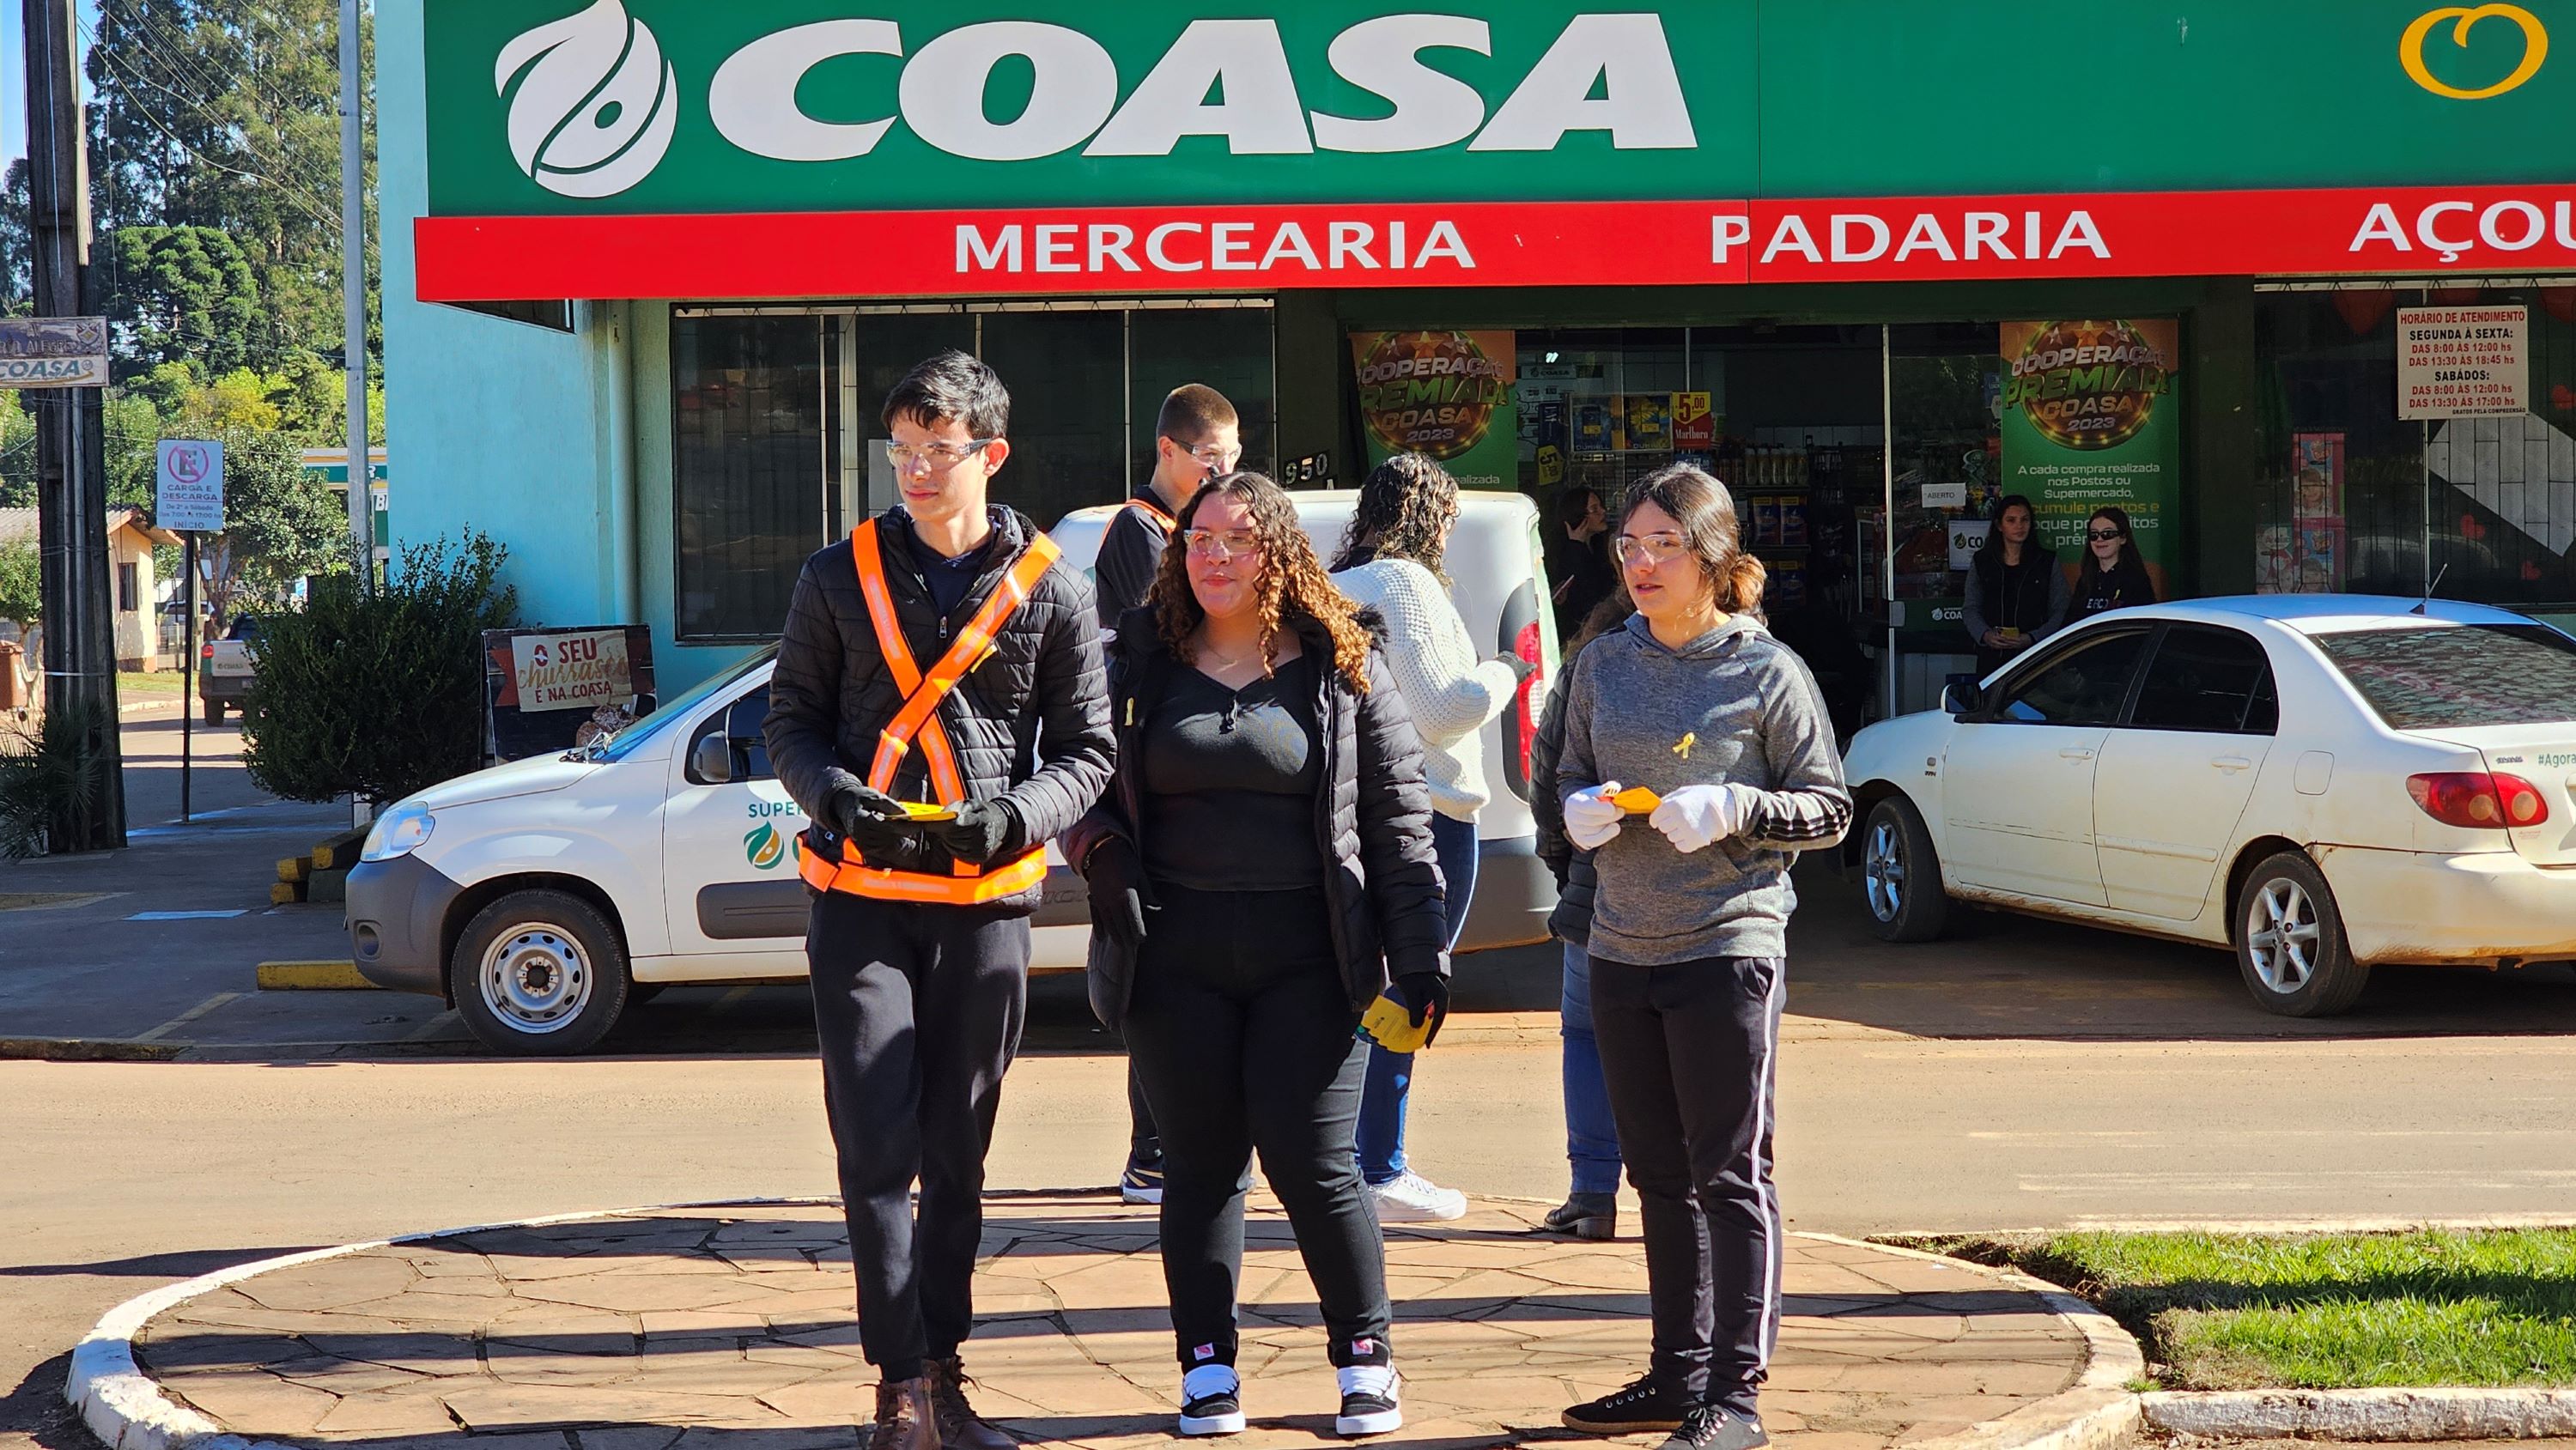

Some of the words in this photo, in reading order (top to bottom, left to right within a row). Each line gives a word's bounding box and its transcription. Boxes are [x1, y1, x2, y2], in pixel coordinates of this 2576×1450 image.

[709, 14, 1697, 161] COASA
[1713, 211, 2111, 263] PADARIA
[957, 222, 1475, 271] MERCEARIA
[2400, 311, 2442, 324] HORÁRIO
[2445, 312, 2458, 323] DE
[2459, 311, 2525, 322] ATENDIMENTO
[2409, 329, 2461, 341] SEGUNDA
[2476, 328, 2513, 338] SEXTA:
[2412, 344, 2430, 354] DAS
[2433, 343, 2454, 353] 8:00
[2501, 343, 2512, 351] hs
[2409, 357, 2427, 366] DAS
[2432, 356, 2457, 366] 13:30
[2476, 355, 2500, 364] 18:45
[2504, 355, 2515, 364] hs
[2435, 368, 2490, 381] SABÁDOS:
[2412, 386, 2431, 395] DAS
[2434, 385, 2454, 394] 8:00
[2474, 385, 2498, 393] 12:00
[2042, 396, 2136, 420] COASA
[2409, 398, 2427, 408] DAS
[2432, 397, 2458, 407] 13:30
[2476, 397, 2501, 405] 17:00
[2505, 397, 2515, 405] hs
[1381, 406, 1473, 429] COASA
[2067, 416, 2116, 432] 2023
[1406, 428, 1455, 443] 2023
[1675, 425, 1709, 440] Marlboro
[1285, 453, 1327, 484] 950
[2018, 465, 2027, 475] A
[2029, 464, 2058, 475] cada
[2061, 465, 2105, 476] compra
[2108, 463, 2160, 473] realizada
[2072, 476, 2113, 486] Postos
[2044, 488, 2135, 499] Supermercado,
[2032, 502, 2087, 514] cumule
[2150, 503, 2160, 513] e
[2035, 519, 2070, 532] oque
[534, 645, 549, 667] O
[558, 638, 598, 664] SEU
[518, 656, 629, 689] churrasco
[548, 687, 567, 701] NA
[572, 681, 612, 698] COASA
